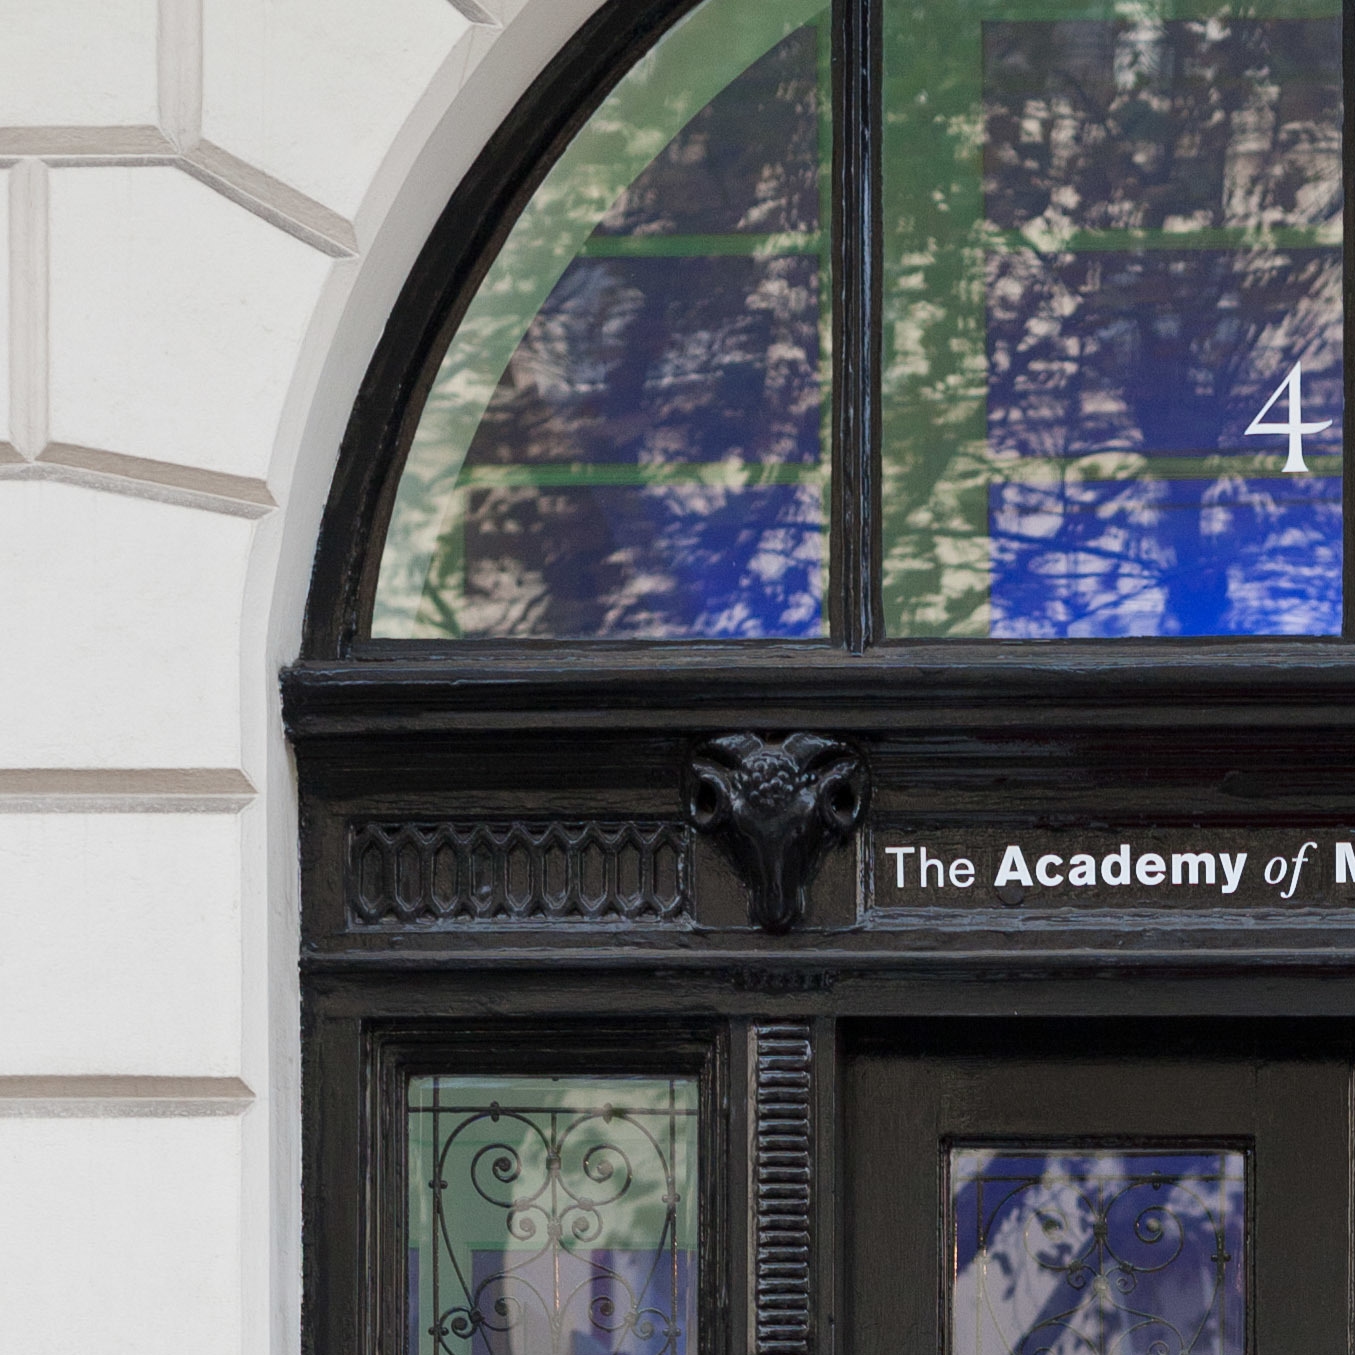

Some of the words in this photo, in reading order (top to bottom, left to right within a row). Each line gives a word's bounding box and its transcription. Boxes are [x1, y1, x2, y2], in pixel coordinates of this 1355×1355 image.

[884, 846, 976, 888] The
[993, 843, 1248, 894] Academy
[1264, 841, 1318, 899] of
